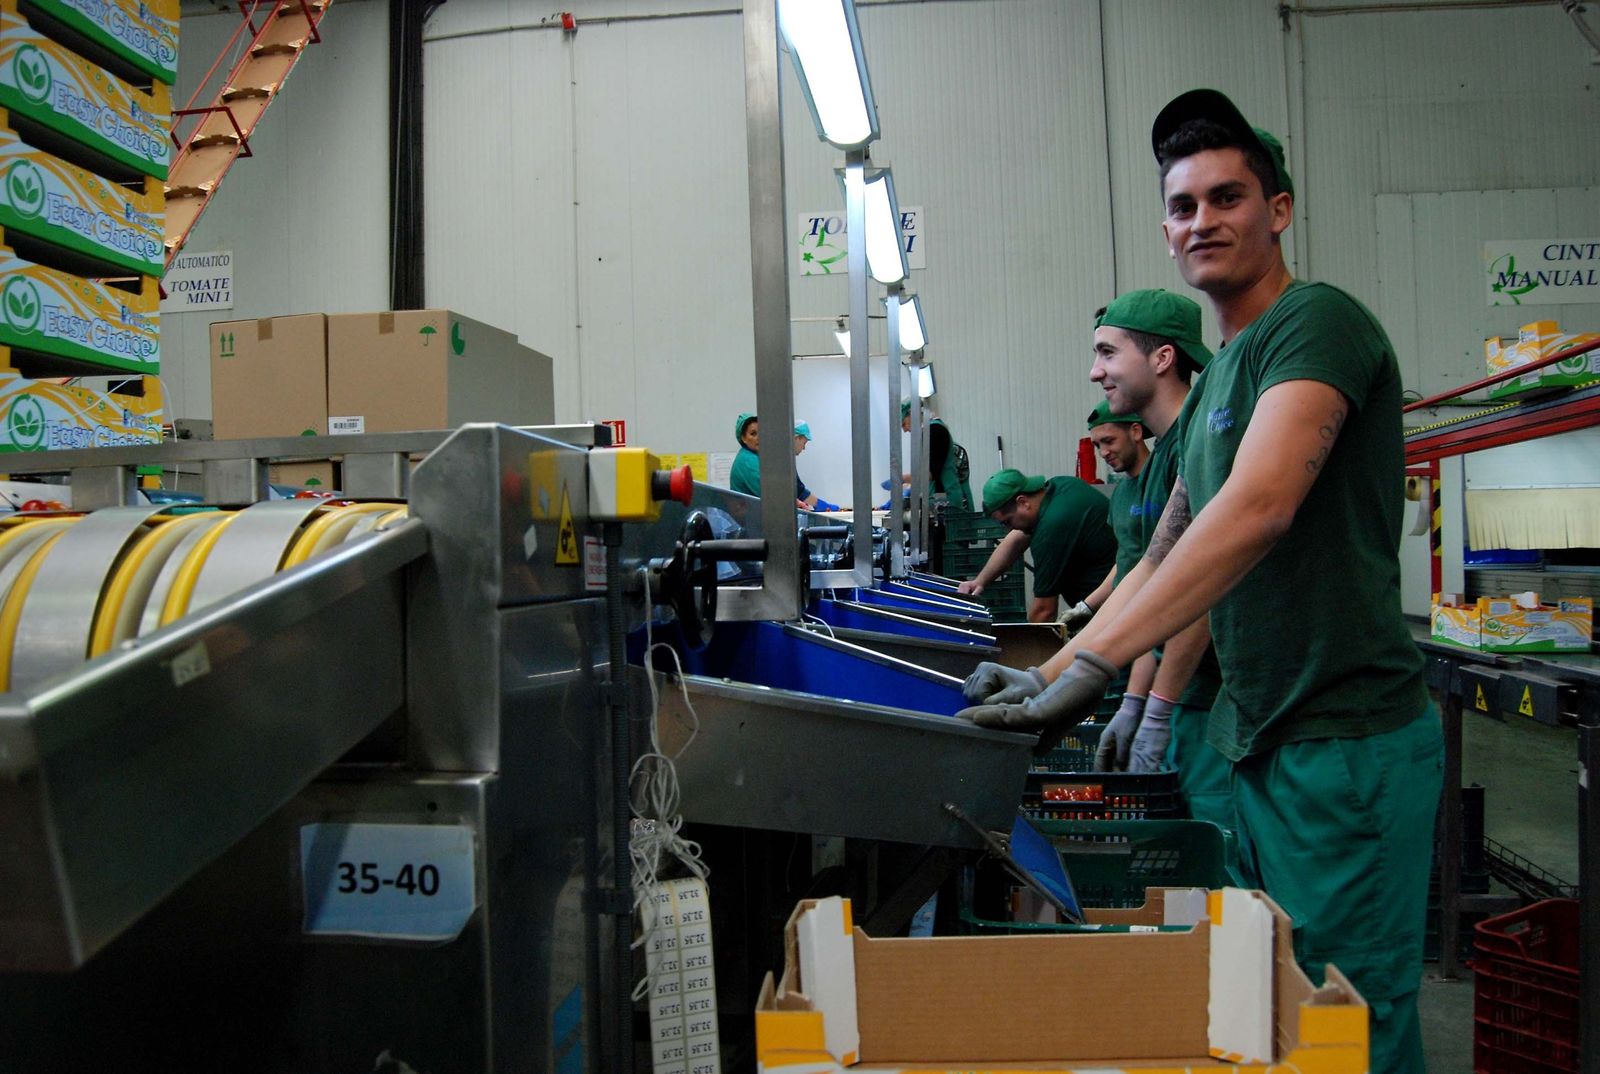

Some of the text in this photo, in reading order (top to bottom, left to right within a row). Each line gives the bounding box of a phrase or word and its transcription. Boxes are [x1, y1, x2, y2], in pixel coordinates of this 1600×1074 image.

[109, 4, 177, 63] Choice
[53, 80, 100, 127] Easy
[101, 106, 168, 158] Choice
[48, 192, 95, 235] Easy
[95, 212, 163, 257] Choice
[176, 255, 229, 269] AUTOMATICO
[1543, 243, 1600, 261] CINT
[170, 278, 230, 292] TOMATE
[1497, 270, 1600, 288] MANUAL
[187, 291, 230, 304] MINI 1
[42, 304, 90, 343] Easy
[91, 318, 158, 356] Choice
[46, 420, 93, 447] Easy
[337, 862, 439, 896] 35-40
